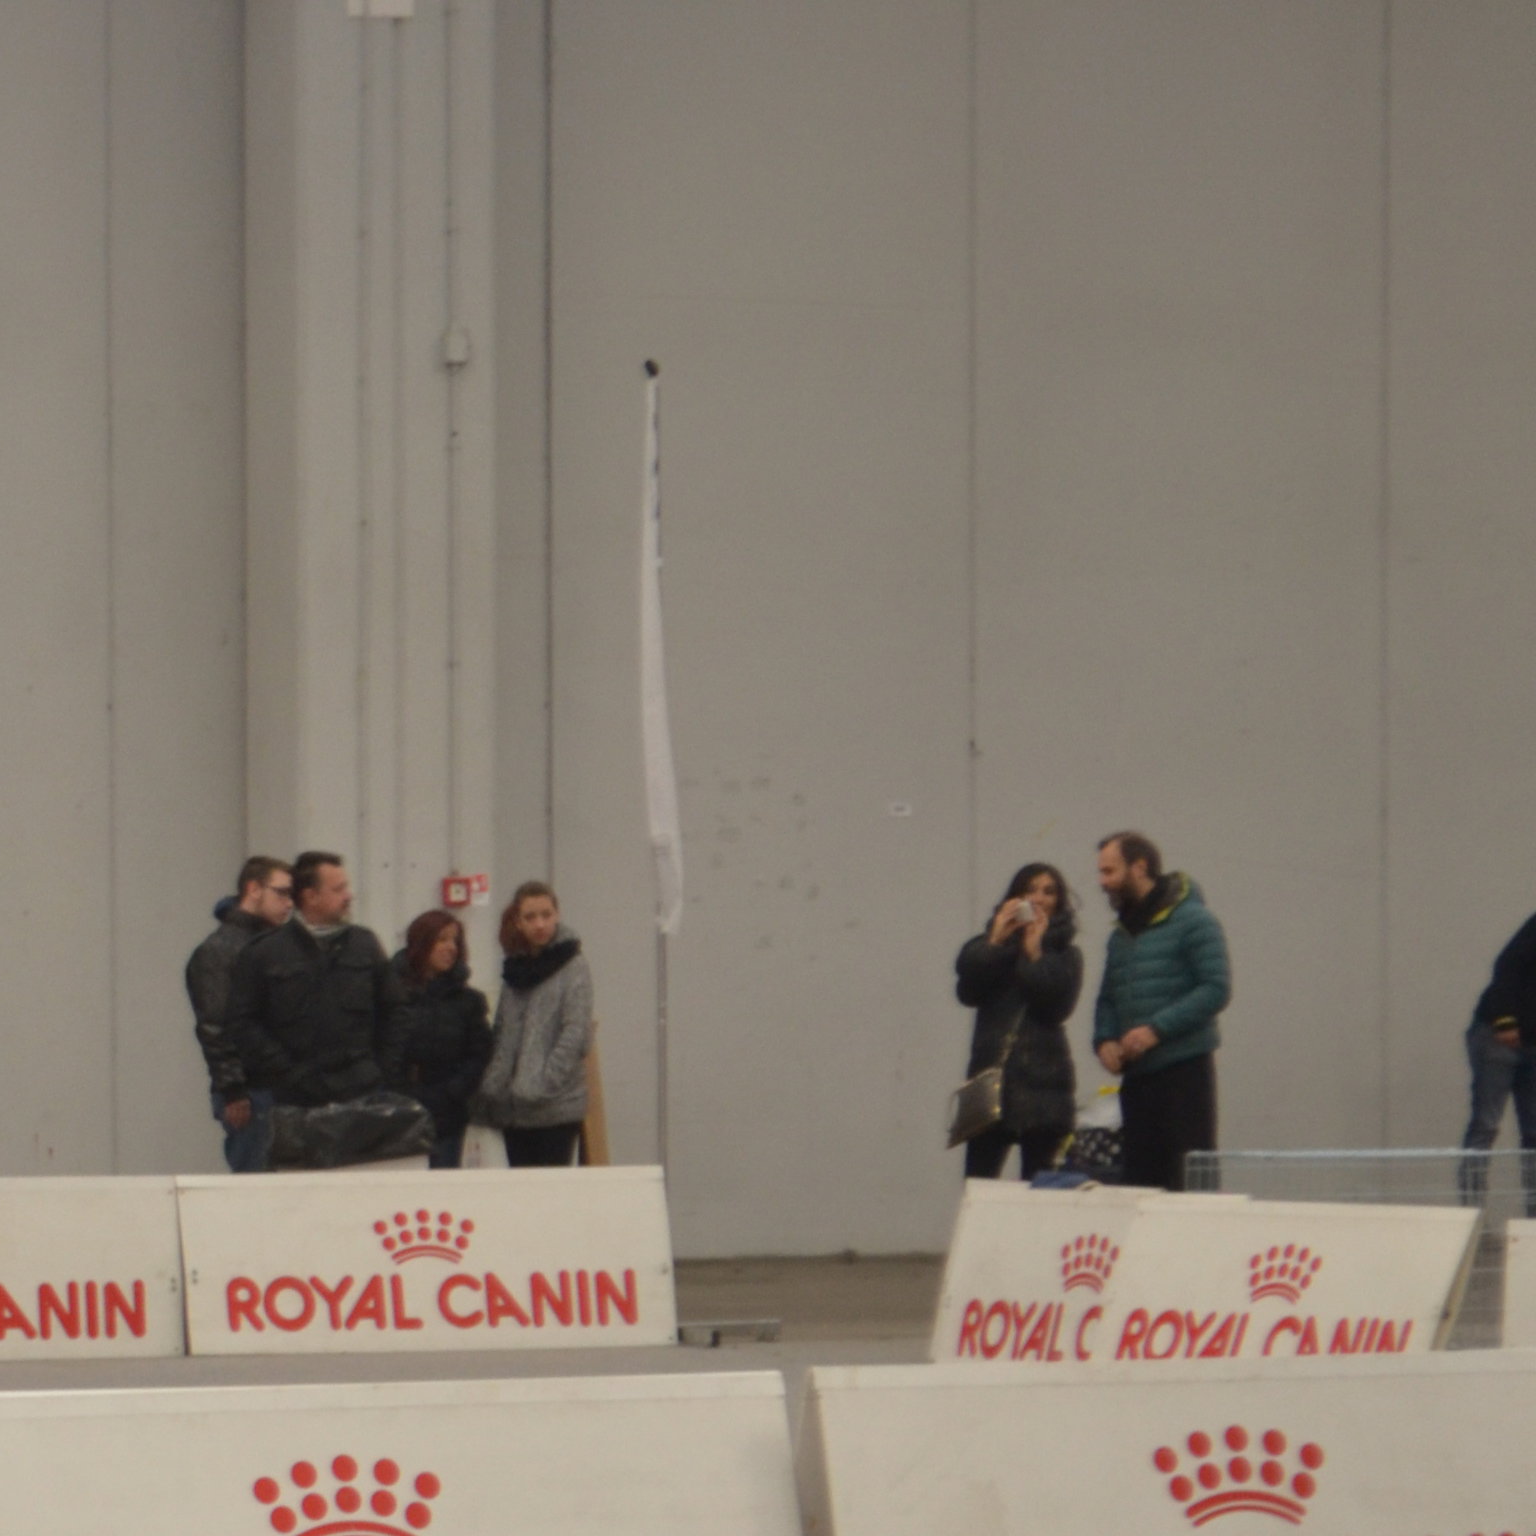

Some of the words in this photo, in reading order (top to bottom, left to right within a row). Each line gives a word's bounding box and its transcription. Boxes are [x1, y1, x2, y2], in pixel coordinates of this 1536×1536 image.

[224, 1272, 426, 1333] ROYAL
[436, 1267, 641, 1331] CANIN
[956, 1298, 1066, 1364] ROYAL
